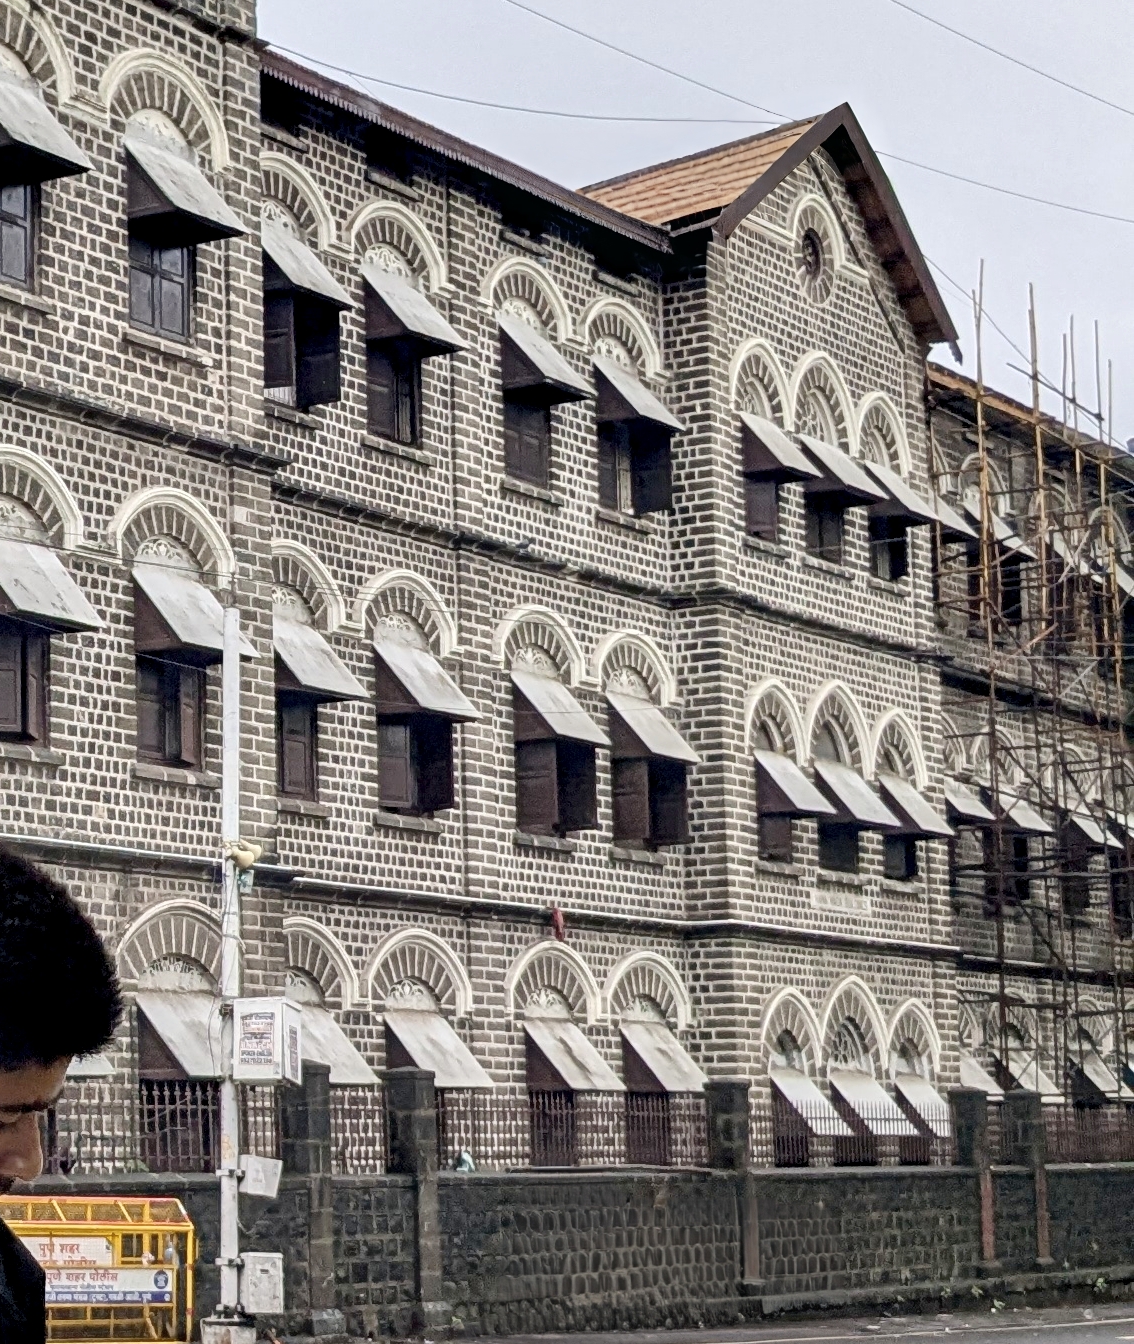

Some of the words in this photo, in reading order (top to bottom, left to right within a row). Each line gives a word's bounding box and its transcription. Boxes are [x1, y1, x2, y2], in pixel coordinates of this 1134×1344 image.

[47, 1268, 62, 1285] पुणे
[65, 1272, 86, 1282] शहर
[89, 1268, 118, 1281] पोलीस
